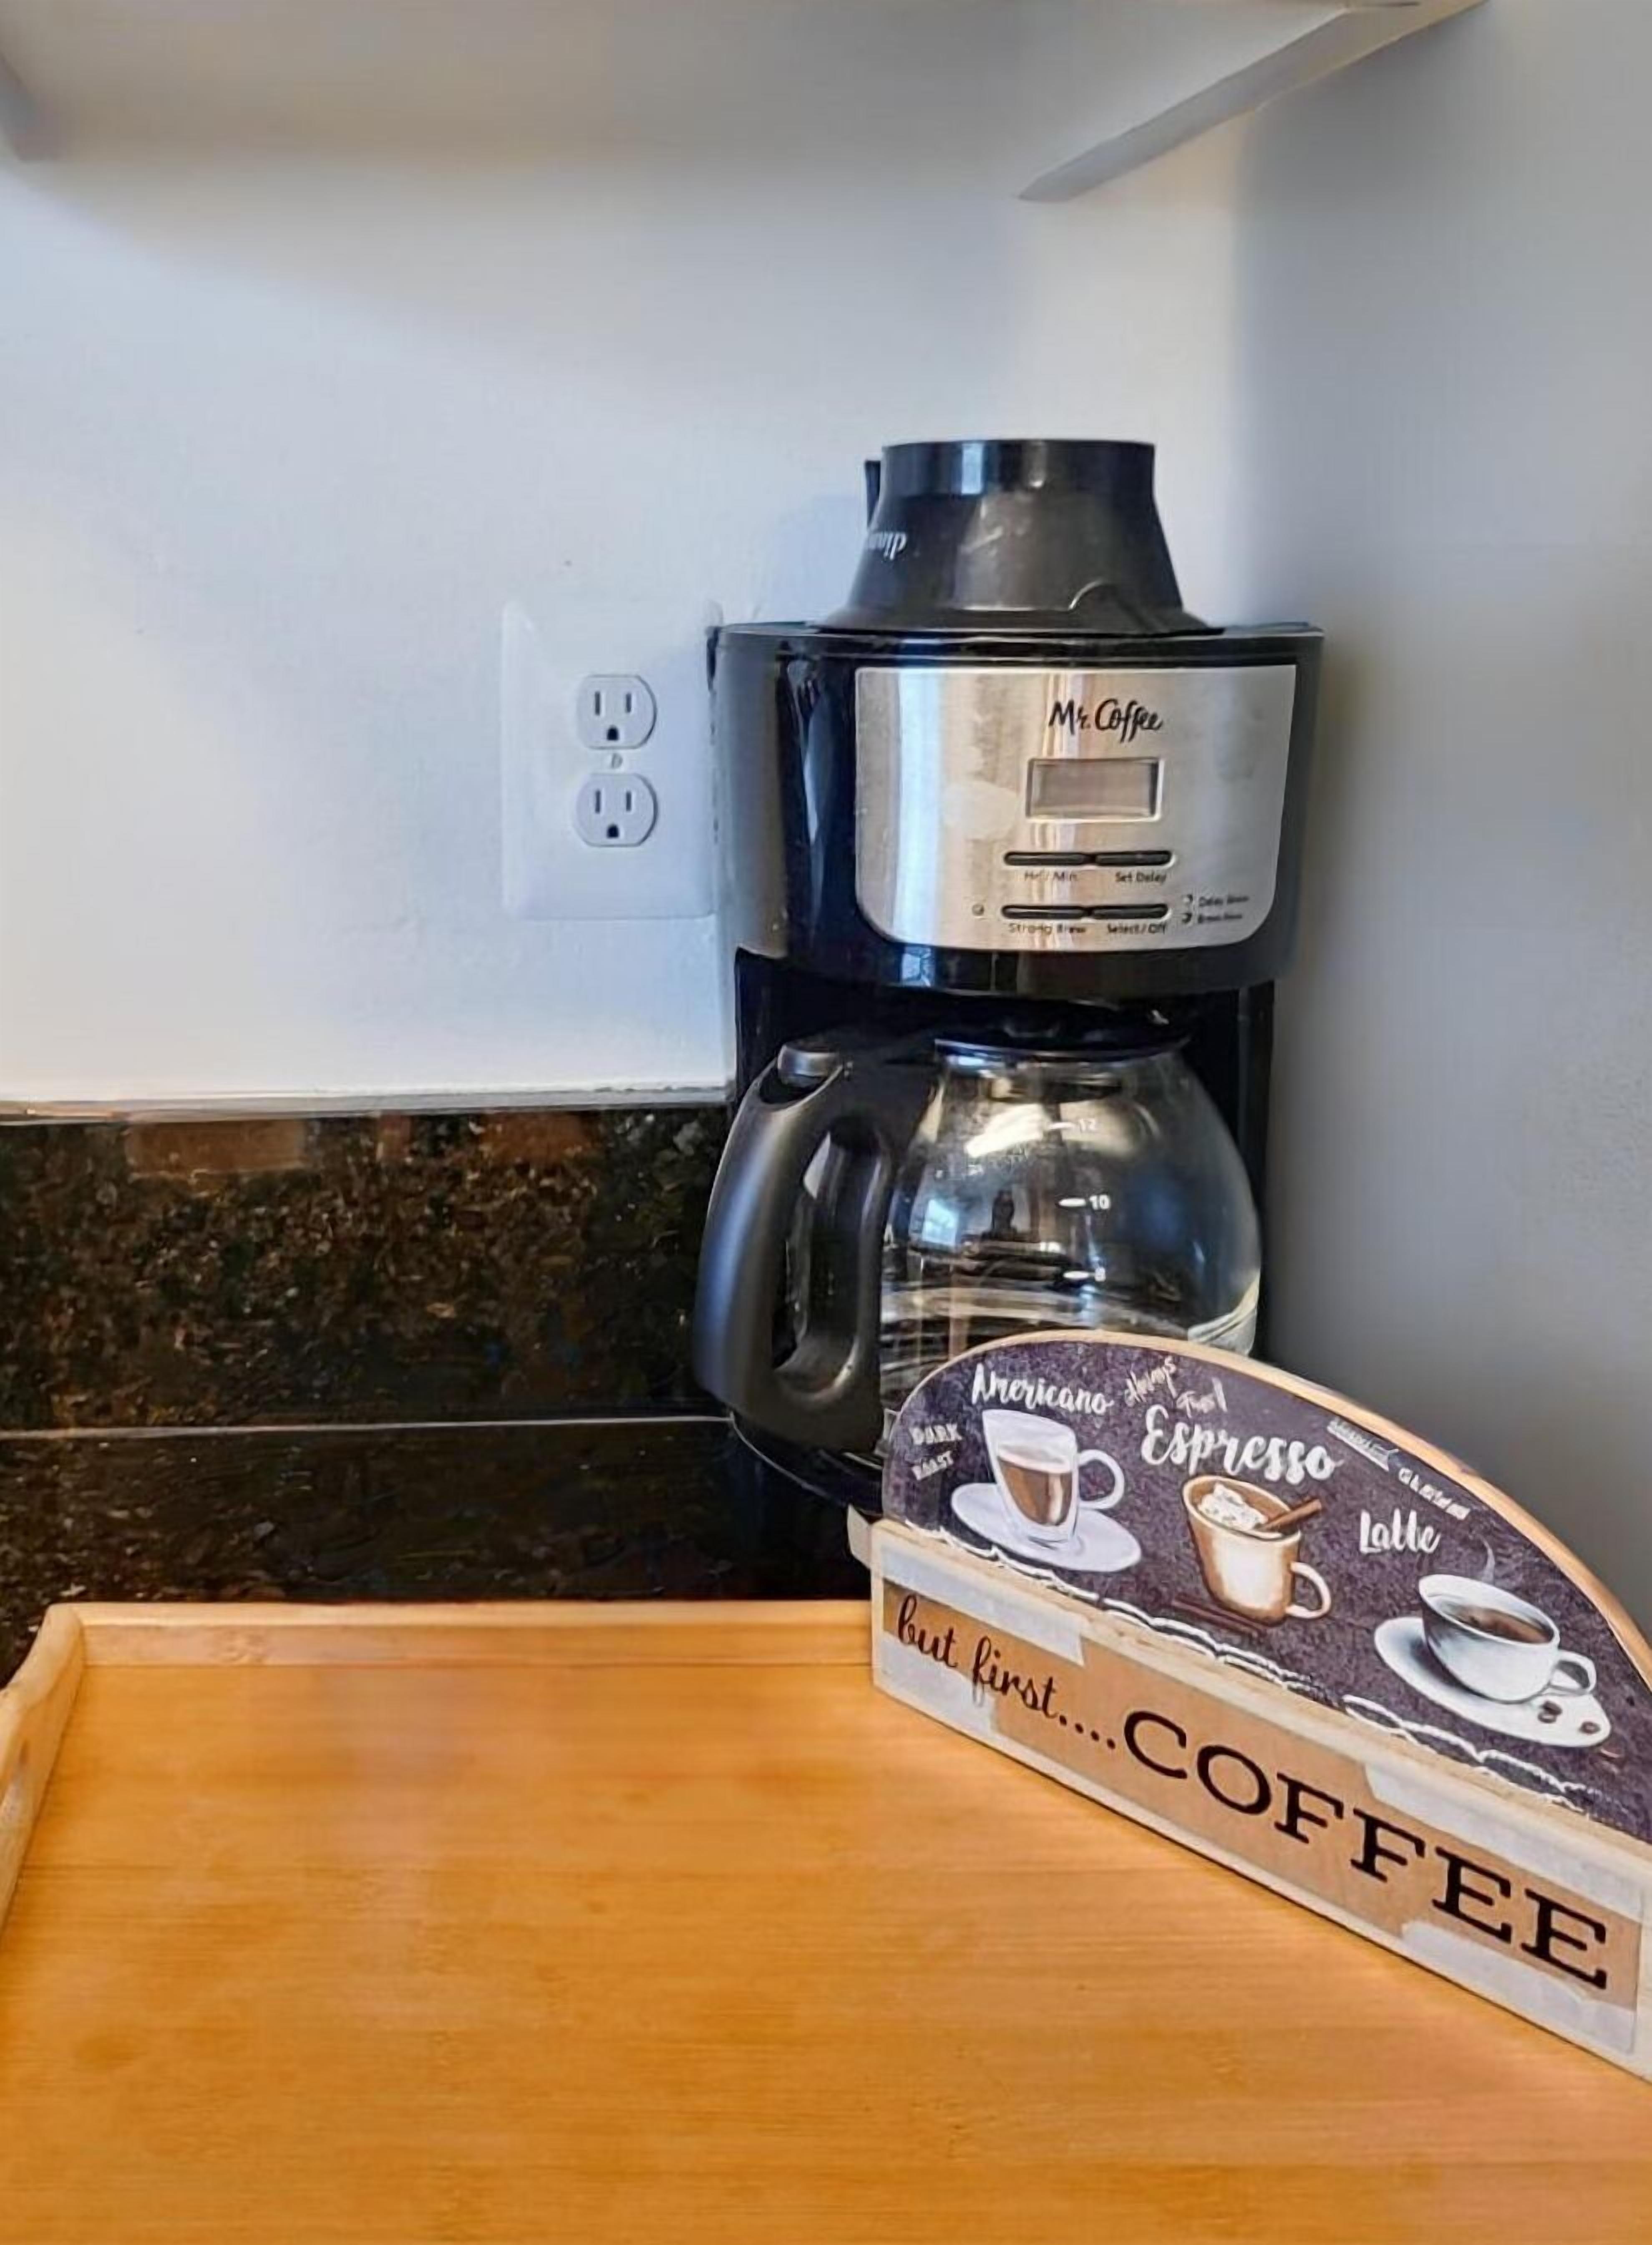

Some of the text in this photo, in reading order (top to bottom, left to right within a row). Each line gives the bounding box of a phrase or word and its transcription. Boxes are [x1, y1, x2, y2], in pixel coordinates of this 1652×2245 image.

[1048, 698, 1163, 744] Mr. Coffee
[1115, 870, 1167, 884] Set Delay
[1008, 923, 1052, 935] Strong
[1089, 1194, 1111, 1210] 10
[971, 1362, 1114, 1415] Americano
[909, 1423, 963, 1445] DARK
[1141, 1404, 1345, 1485] Espresso
[1359, 1509, 1441, 1554] Latte
[898, 1594, 958, 1668] but
[1123, 1710, 1608, 1991] COFFEE
